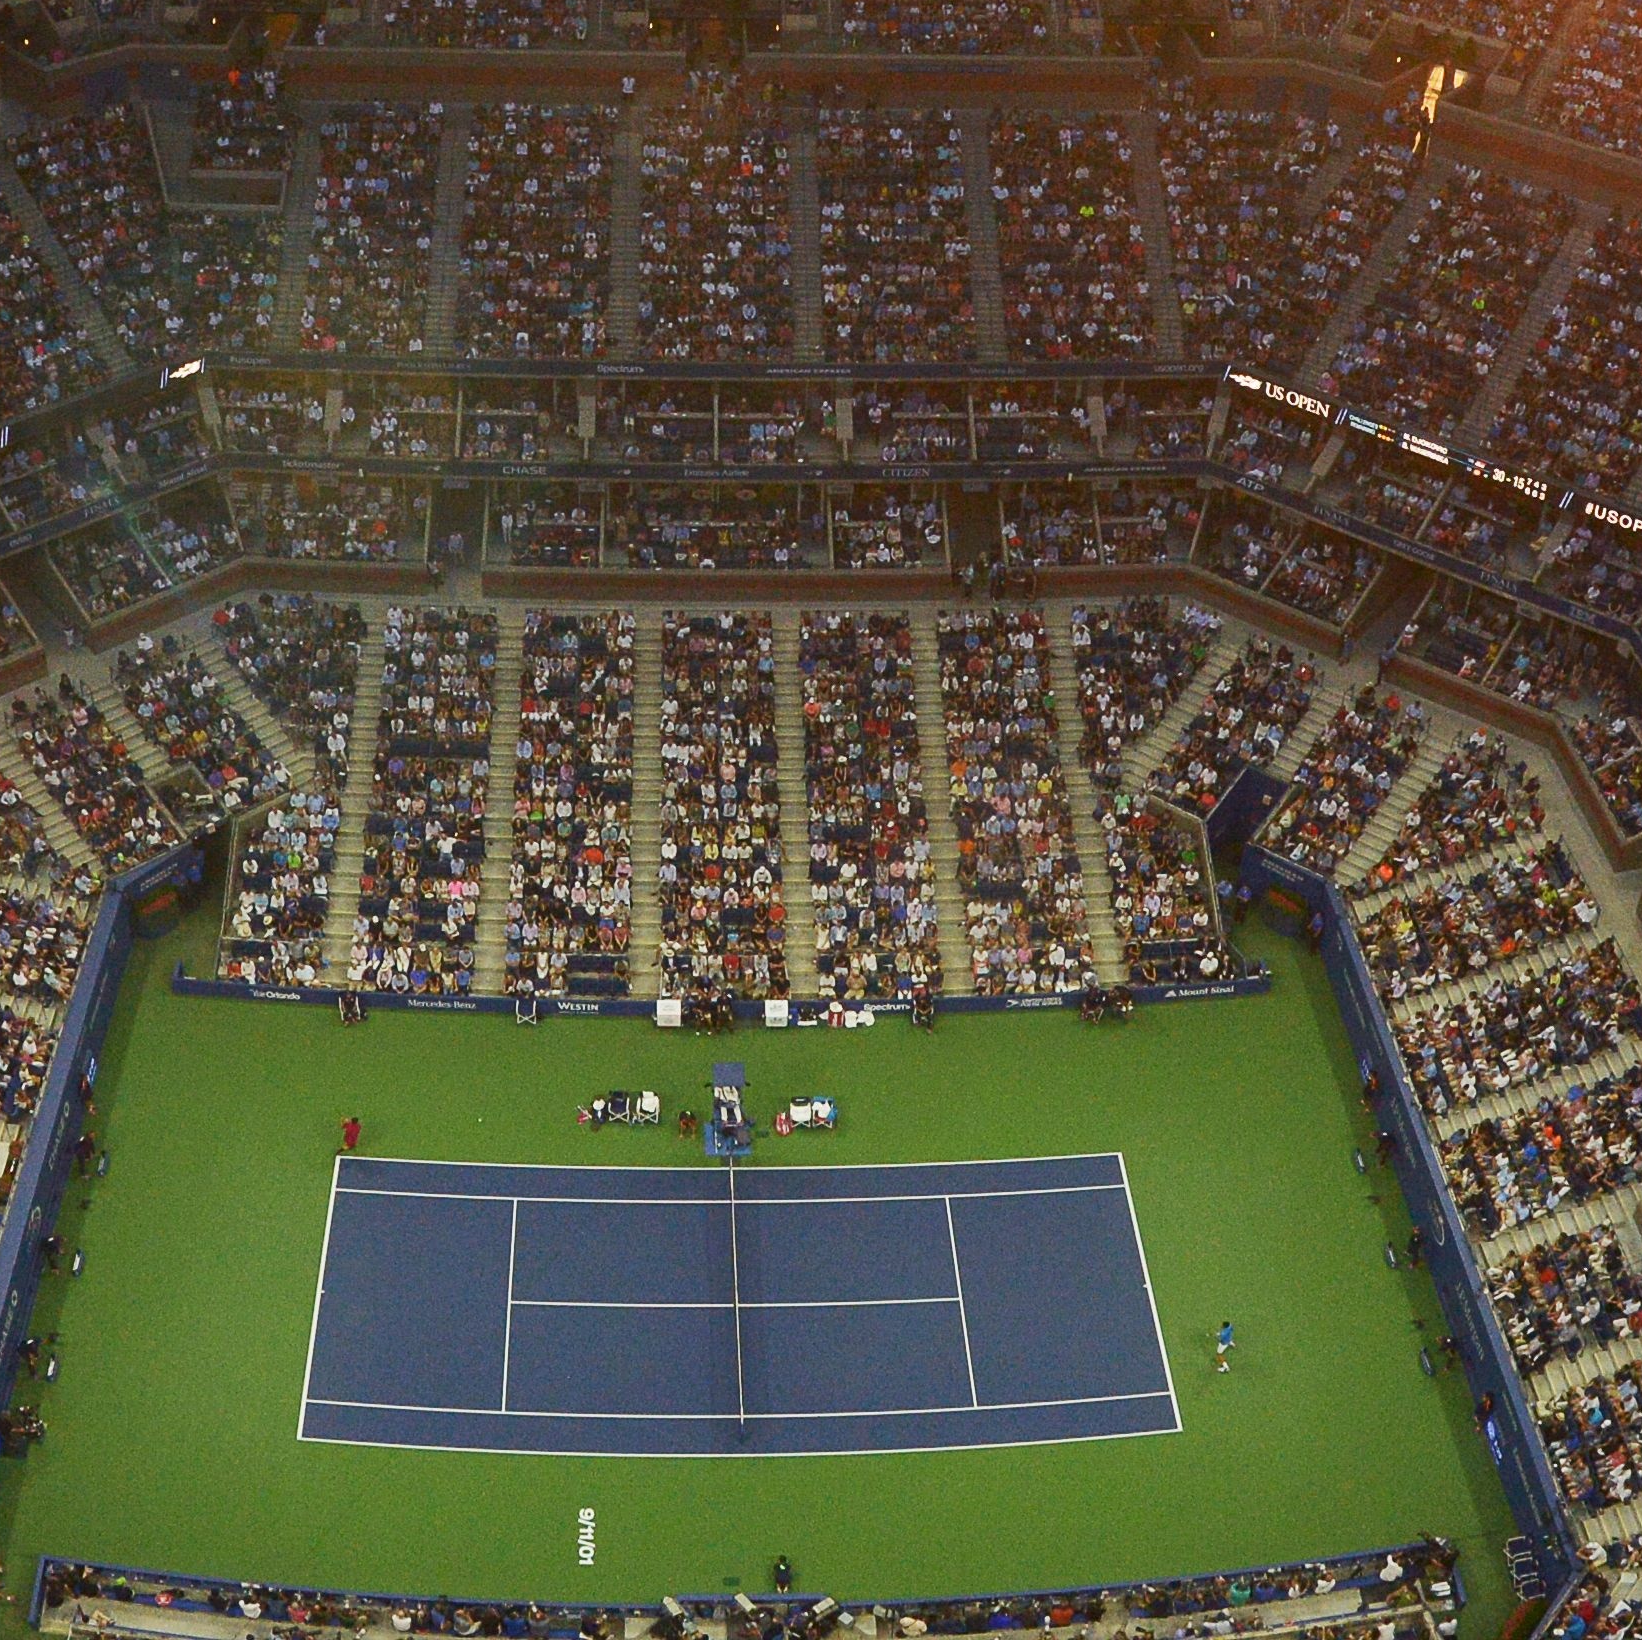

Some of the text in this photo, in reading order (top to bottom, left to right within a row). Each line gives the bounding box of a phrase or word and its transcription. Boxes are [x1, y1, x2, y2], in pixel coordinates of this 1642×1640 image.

[1265, 381, 1330, 418] US OPEN
[502, 463, 547, 476] CHASE
[881, 467, 930, 477] CITIZEN
[1235, 474, 1265, 493] ATP
[1492, 468, 1506, 483] 30
[1513, 475, 1525, 490] 15
[265, 991, 301, 1001] Orlando
[1179, 987, 1208, 997] Mount
[557, 1001, 599, 1012] WESTIN
[864, 1003, 906, 1014] Spectrum
[578, 1507, 596, 1566] 9/11/01
